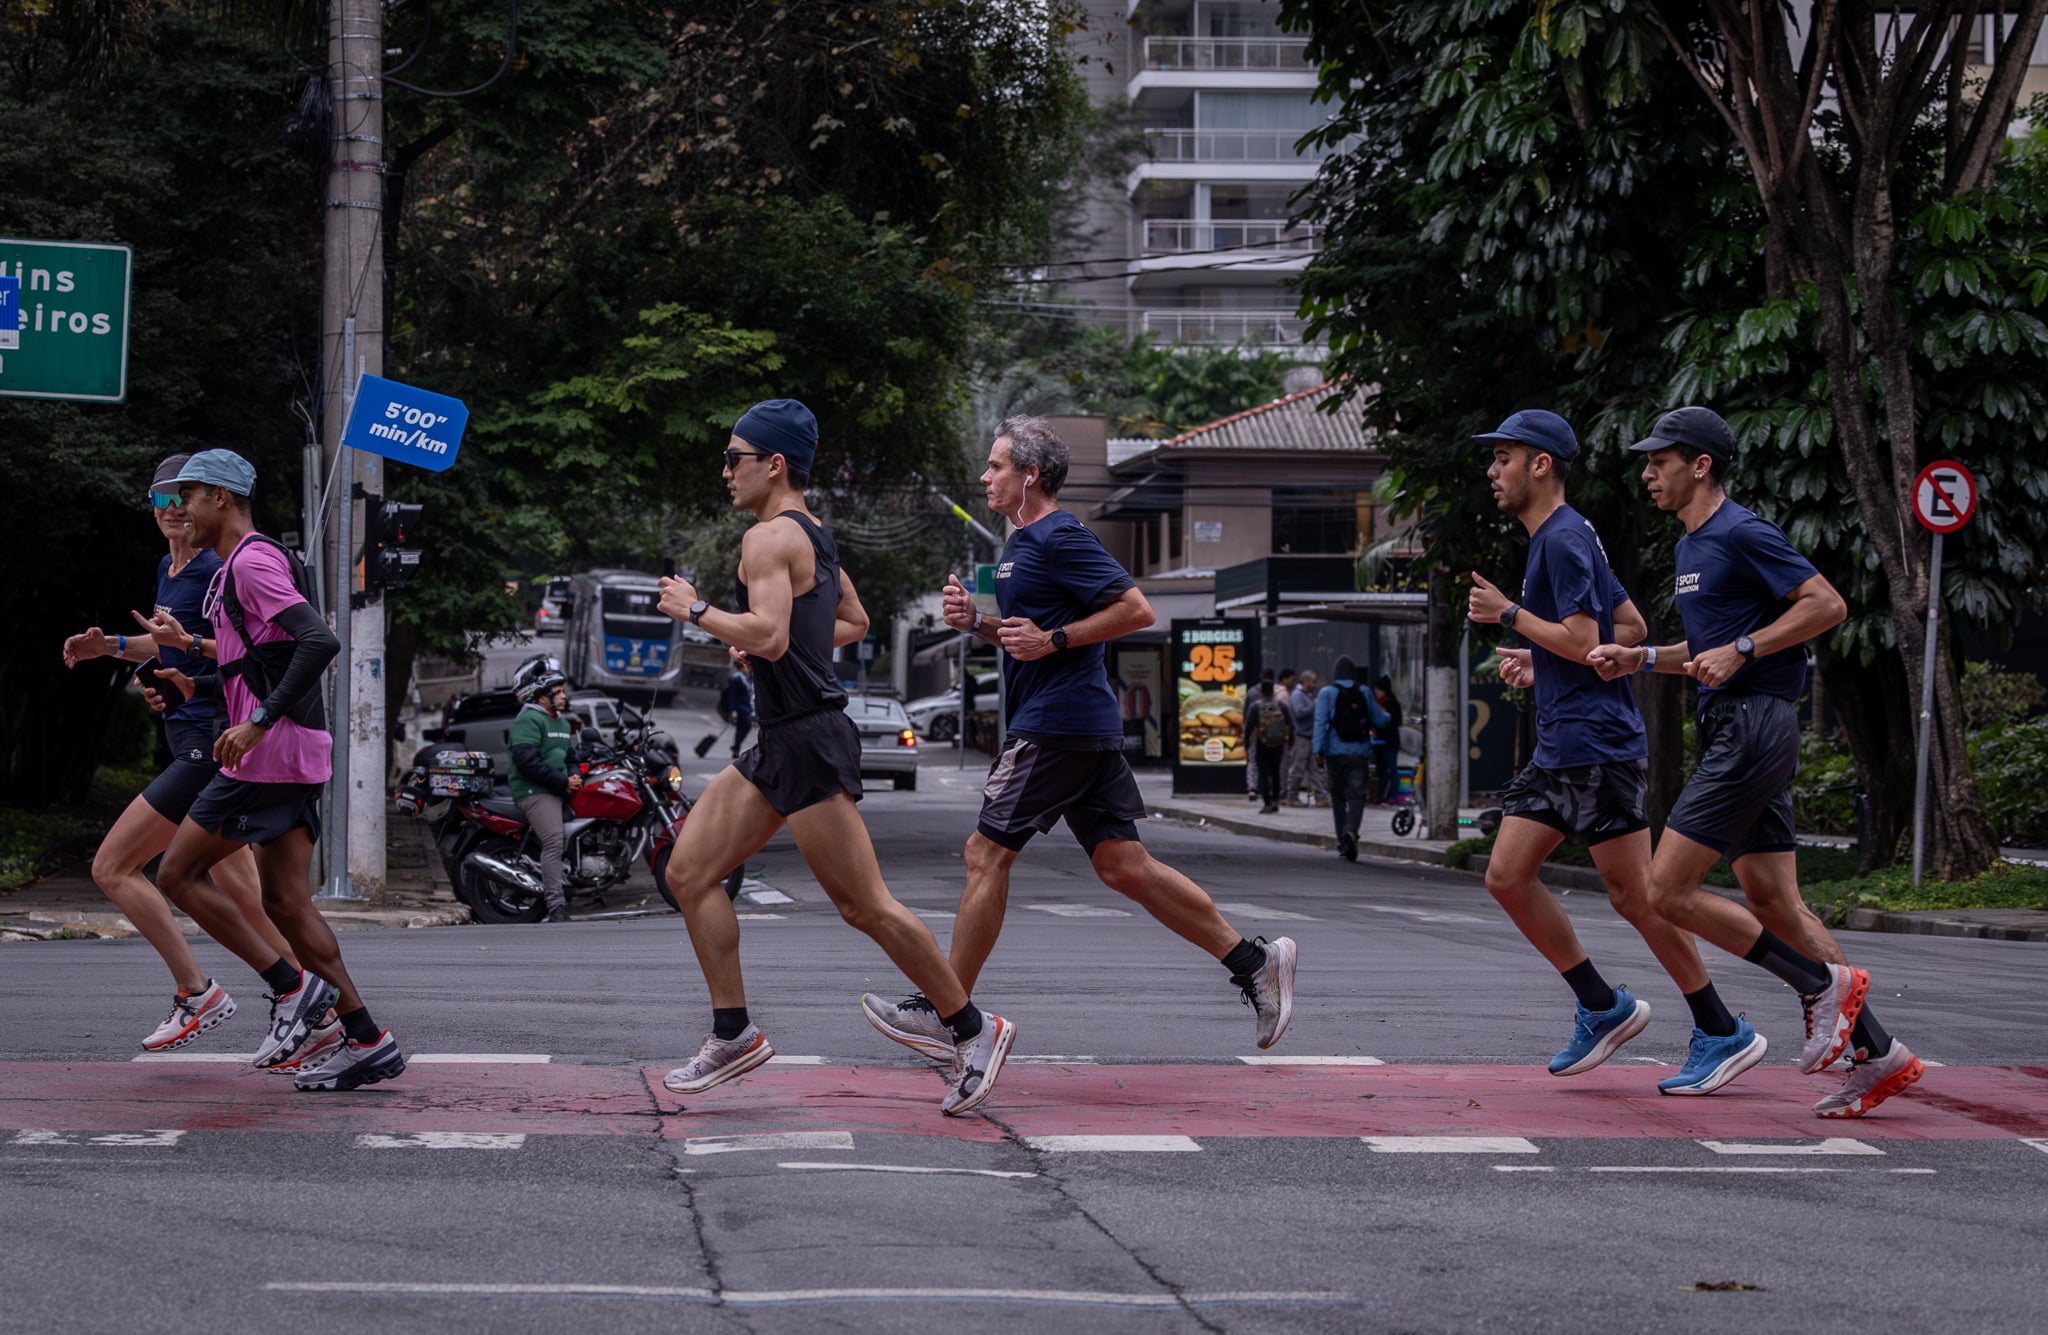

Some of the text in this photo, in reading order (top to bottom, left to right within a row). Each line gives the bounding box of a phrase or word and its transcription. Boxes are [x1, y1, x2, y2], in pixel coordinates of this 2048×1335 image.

[0, 261, 75, 293] ins
[369, 423, 447, 454] min/km
[1190, 645, 1235, 682] 25
[724, 1031, 758, 1063] RUNNING
